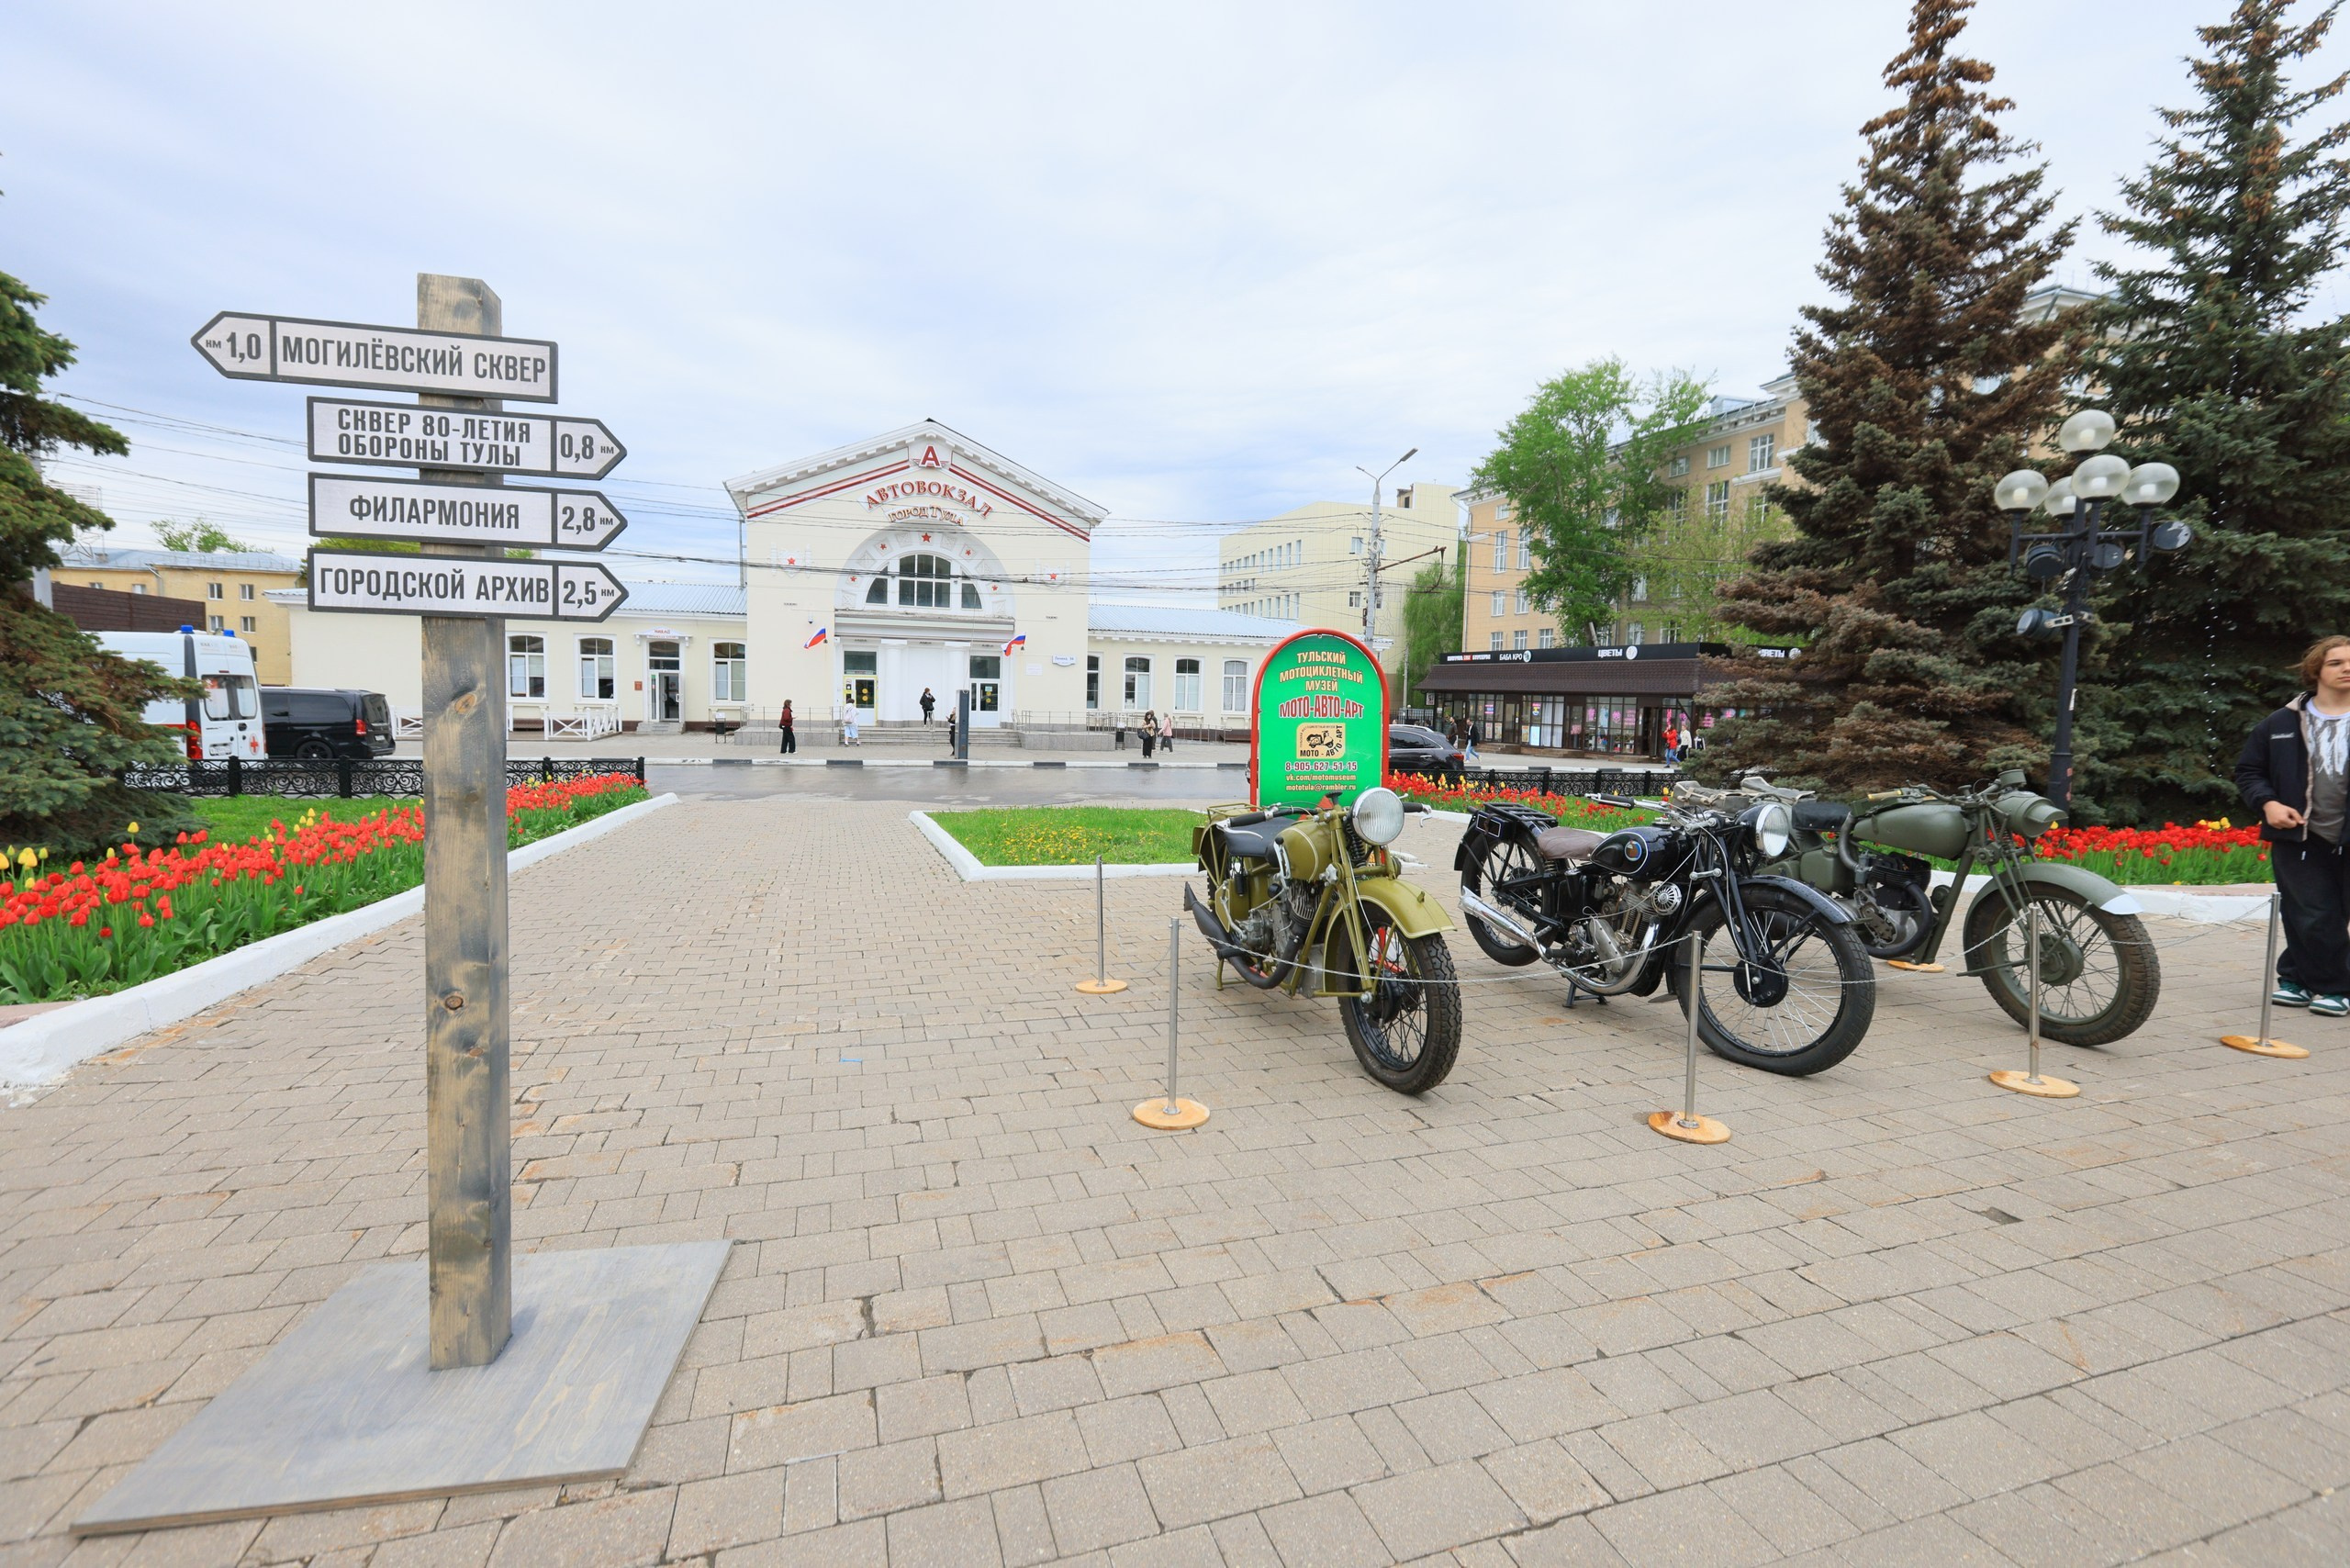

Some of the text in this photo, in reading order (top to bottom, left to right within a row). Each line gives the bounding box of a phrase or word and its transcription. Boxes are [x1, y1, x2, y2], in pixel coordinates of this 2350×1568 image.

[226, 331, 262, 364] 1,0
[283, 334, 546, 384] МОГИЛЁВСКИЙ СКВЕР
[338, 409, 532, 444] СКВЕР 80-ЛЕТИЯ
[338, 432, 521, 467] ОБОРОНЫ ТУЛЫ
[560, 432, 595, 464] 0,8
[350, 495, 520, 531] ФИЛАРМОНИЯ
[866, 480, 994, 520] АВТОВОКЗАЛ
[562, 505, 596, 535] 2,8
[888, 506, 929, 522] ГОРОД
[320, 567, 550, 604] ГОРОДСКОЙ АРХИВ
[563, 579, 597, 609] 2,5
[1297, 651, 1346, 665] ТУЛЬСКИЙ
[1598, 648, 1623, 658] ЦВЕТЫ
[1280, 666, 1363, 684] МОТОЦИКЛЕТНЫЙ
[1305, 678, 1338, 692] МУЗЕЙ
[1279, 695, 1364, 719] МОТО-АВТО-АРТ
[1285, 761, 1358, 772] 8-905-627-51-15
[1300, 749, 1319, 757] МОТО
[1285, 773, 1357, 782] vk.com/motomuseum
[1285, 784, 1357, 792] mototula@rambler.ru
